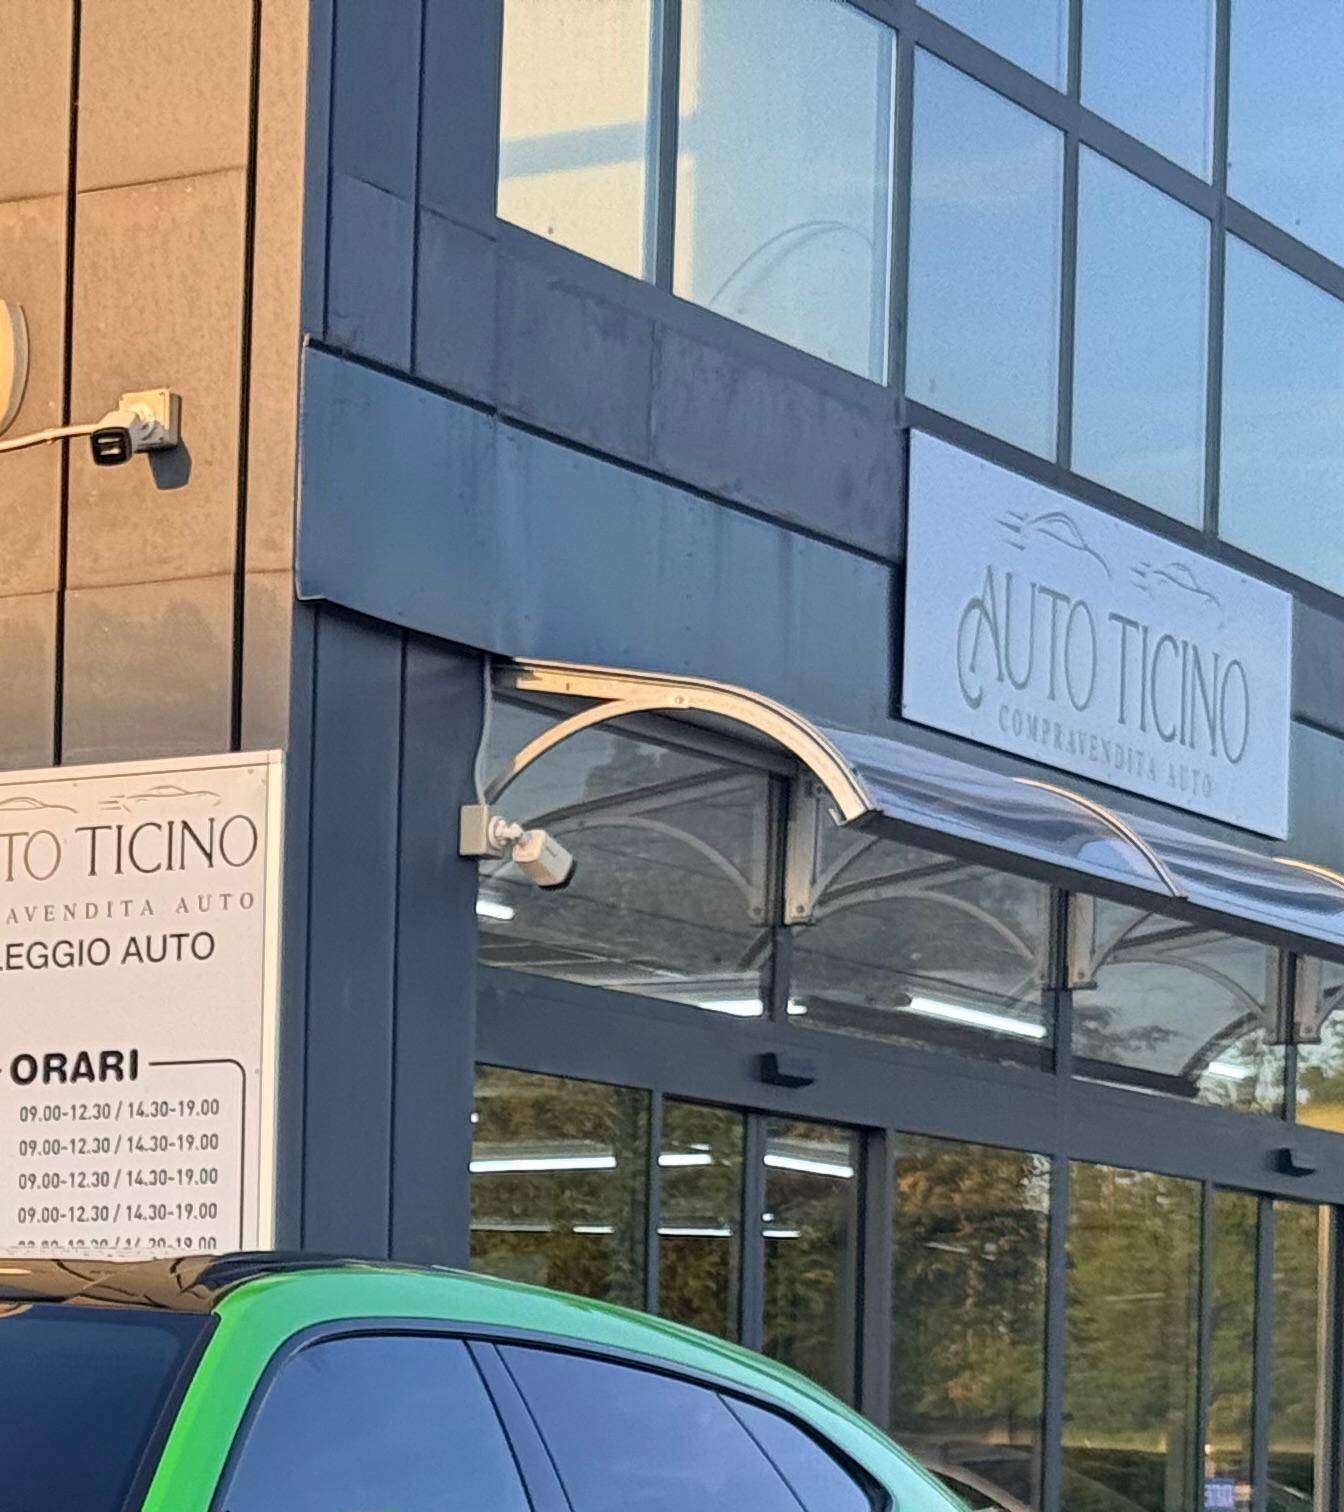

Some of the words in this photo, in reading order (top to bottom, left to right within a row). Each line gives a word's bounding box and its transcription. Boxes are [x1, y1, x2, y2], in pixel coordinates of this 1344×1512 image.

[956, 564, 1097, 713] AUTO
[1108, 611, 1250, 765] TICINO
[998, 704, 1157, 782] COMPRAVENDITA
[1168, 762, 1213, 798] AUTO
[75, 814, 259, 878] TICINO
[175, 891, 256, 914] AUTO
[120, 931, 216, 965] AUTO
[9, 1048, 140, 1086] ORARI
[19, 1102, 112, 1123] 09.00-12.30
[127, 1098, 220, 1119] 14.30-19.00
[18, 1137, 111, 1157] 09.00-12.30
[127, 1133, 220, 1153] 14.30-19.00
[18, 1171, 111, 1191] 09.00-12.30
[126, 1167, 219, 1187] 14.30-19.00
[17, 1205, 110, 1225] 09.00-12.30
[126, 1202, 219, 1222] 14.30-19.00
